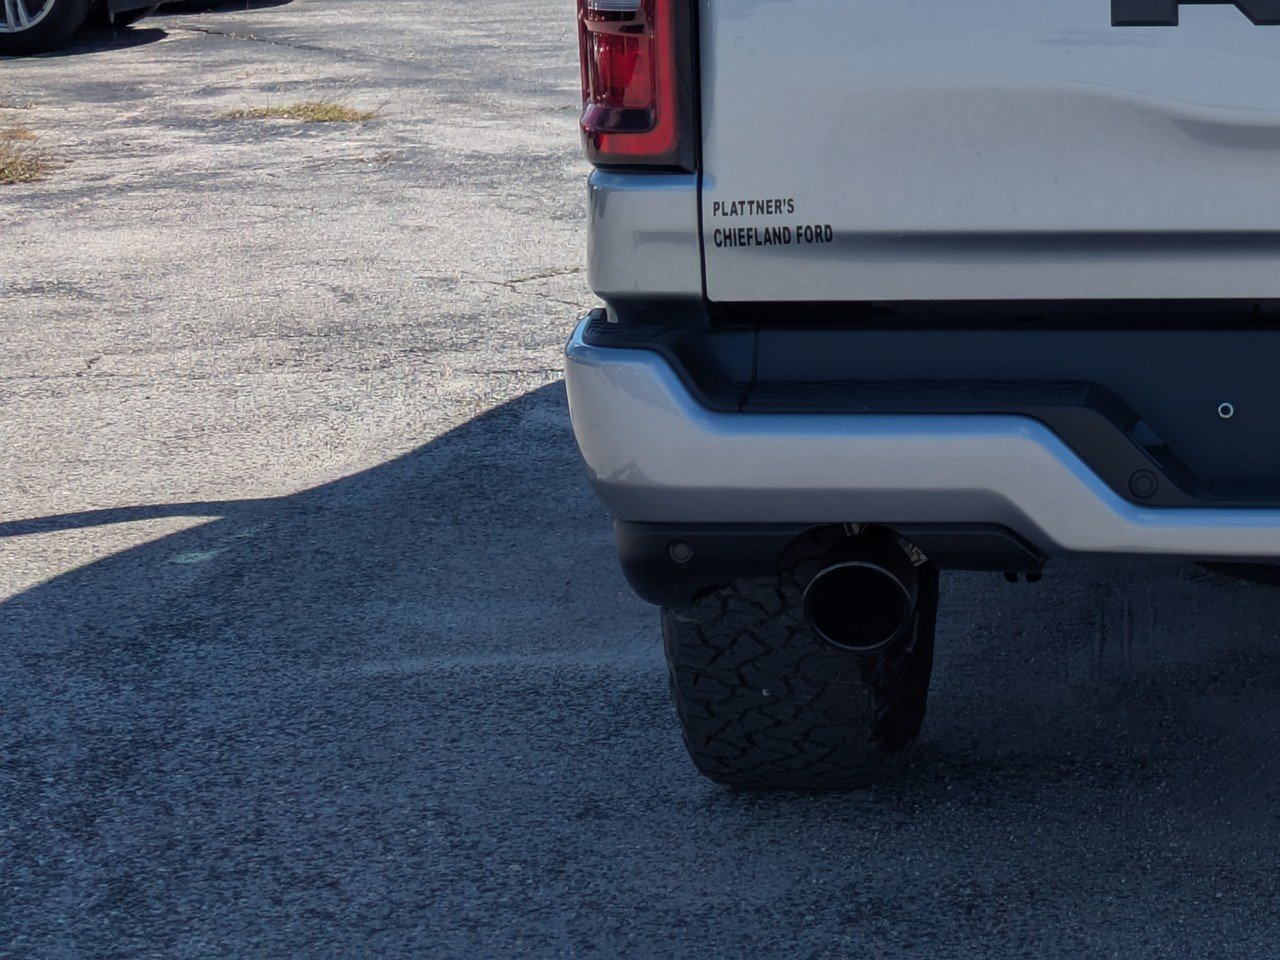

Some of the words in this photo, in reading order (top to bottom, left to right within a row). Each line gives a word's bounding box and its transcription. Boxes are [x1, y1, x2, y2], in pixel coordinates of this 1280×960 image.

[713, 198, 795, 217] PLATTNER'S
[713, 227, 792, 248] CHIEFLAND
[796, 224, 833, 243] FORD
